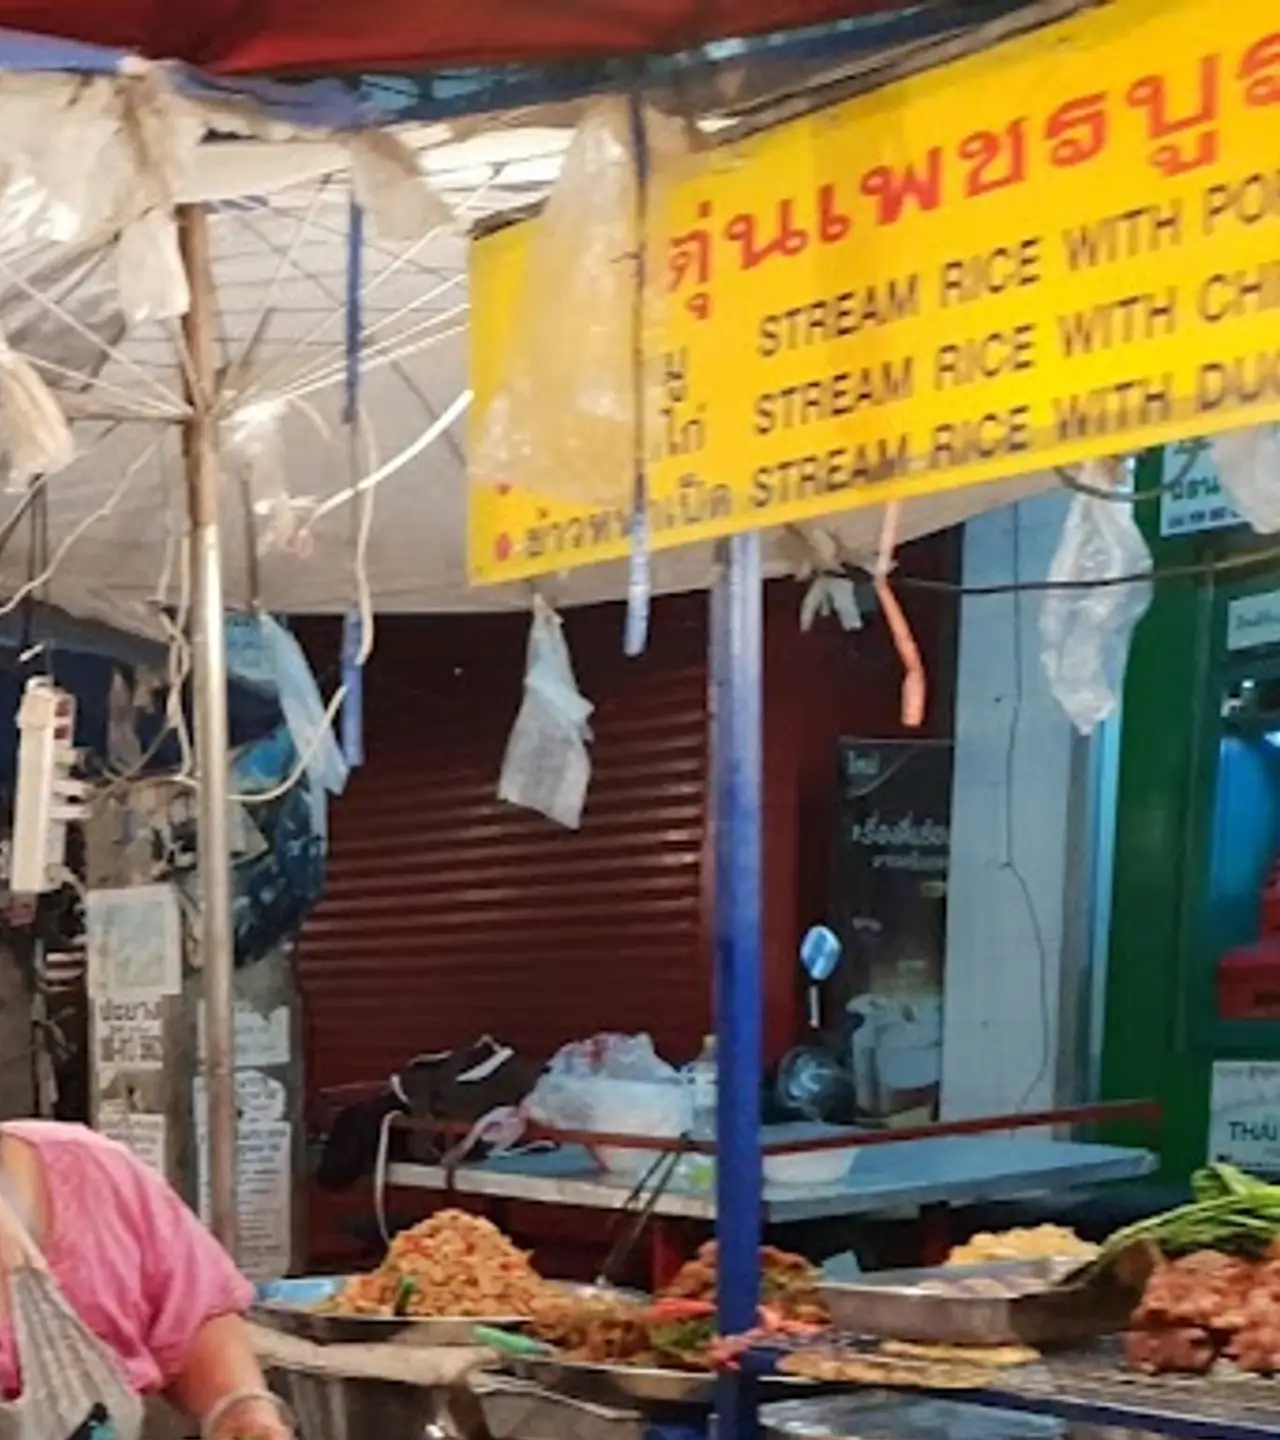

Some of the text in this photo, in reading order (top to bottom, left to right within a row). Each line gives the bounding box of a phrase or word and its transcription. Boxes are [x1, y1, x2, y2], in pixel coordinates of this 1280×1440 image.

[758, 169, 1280, 358] STREAM RICE WITH PO
[748, 349, 1280, 508] STREAM RICE WITH DU
[754, 355, 914, 436] STREAM
[934, 322, 1037, 391] RICE
[1057, 286, 1178, 358] WITH
